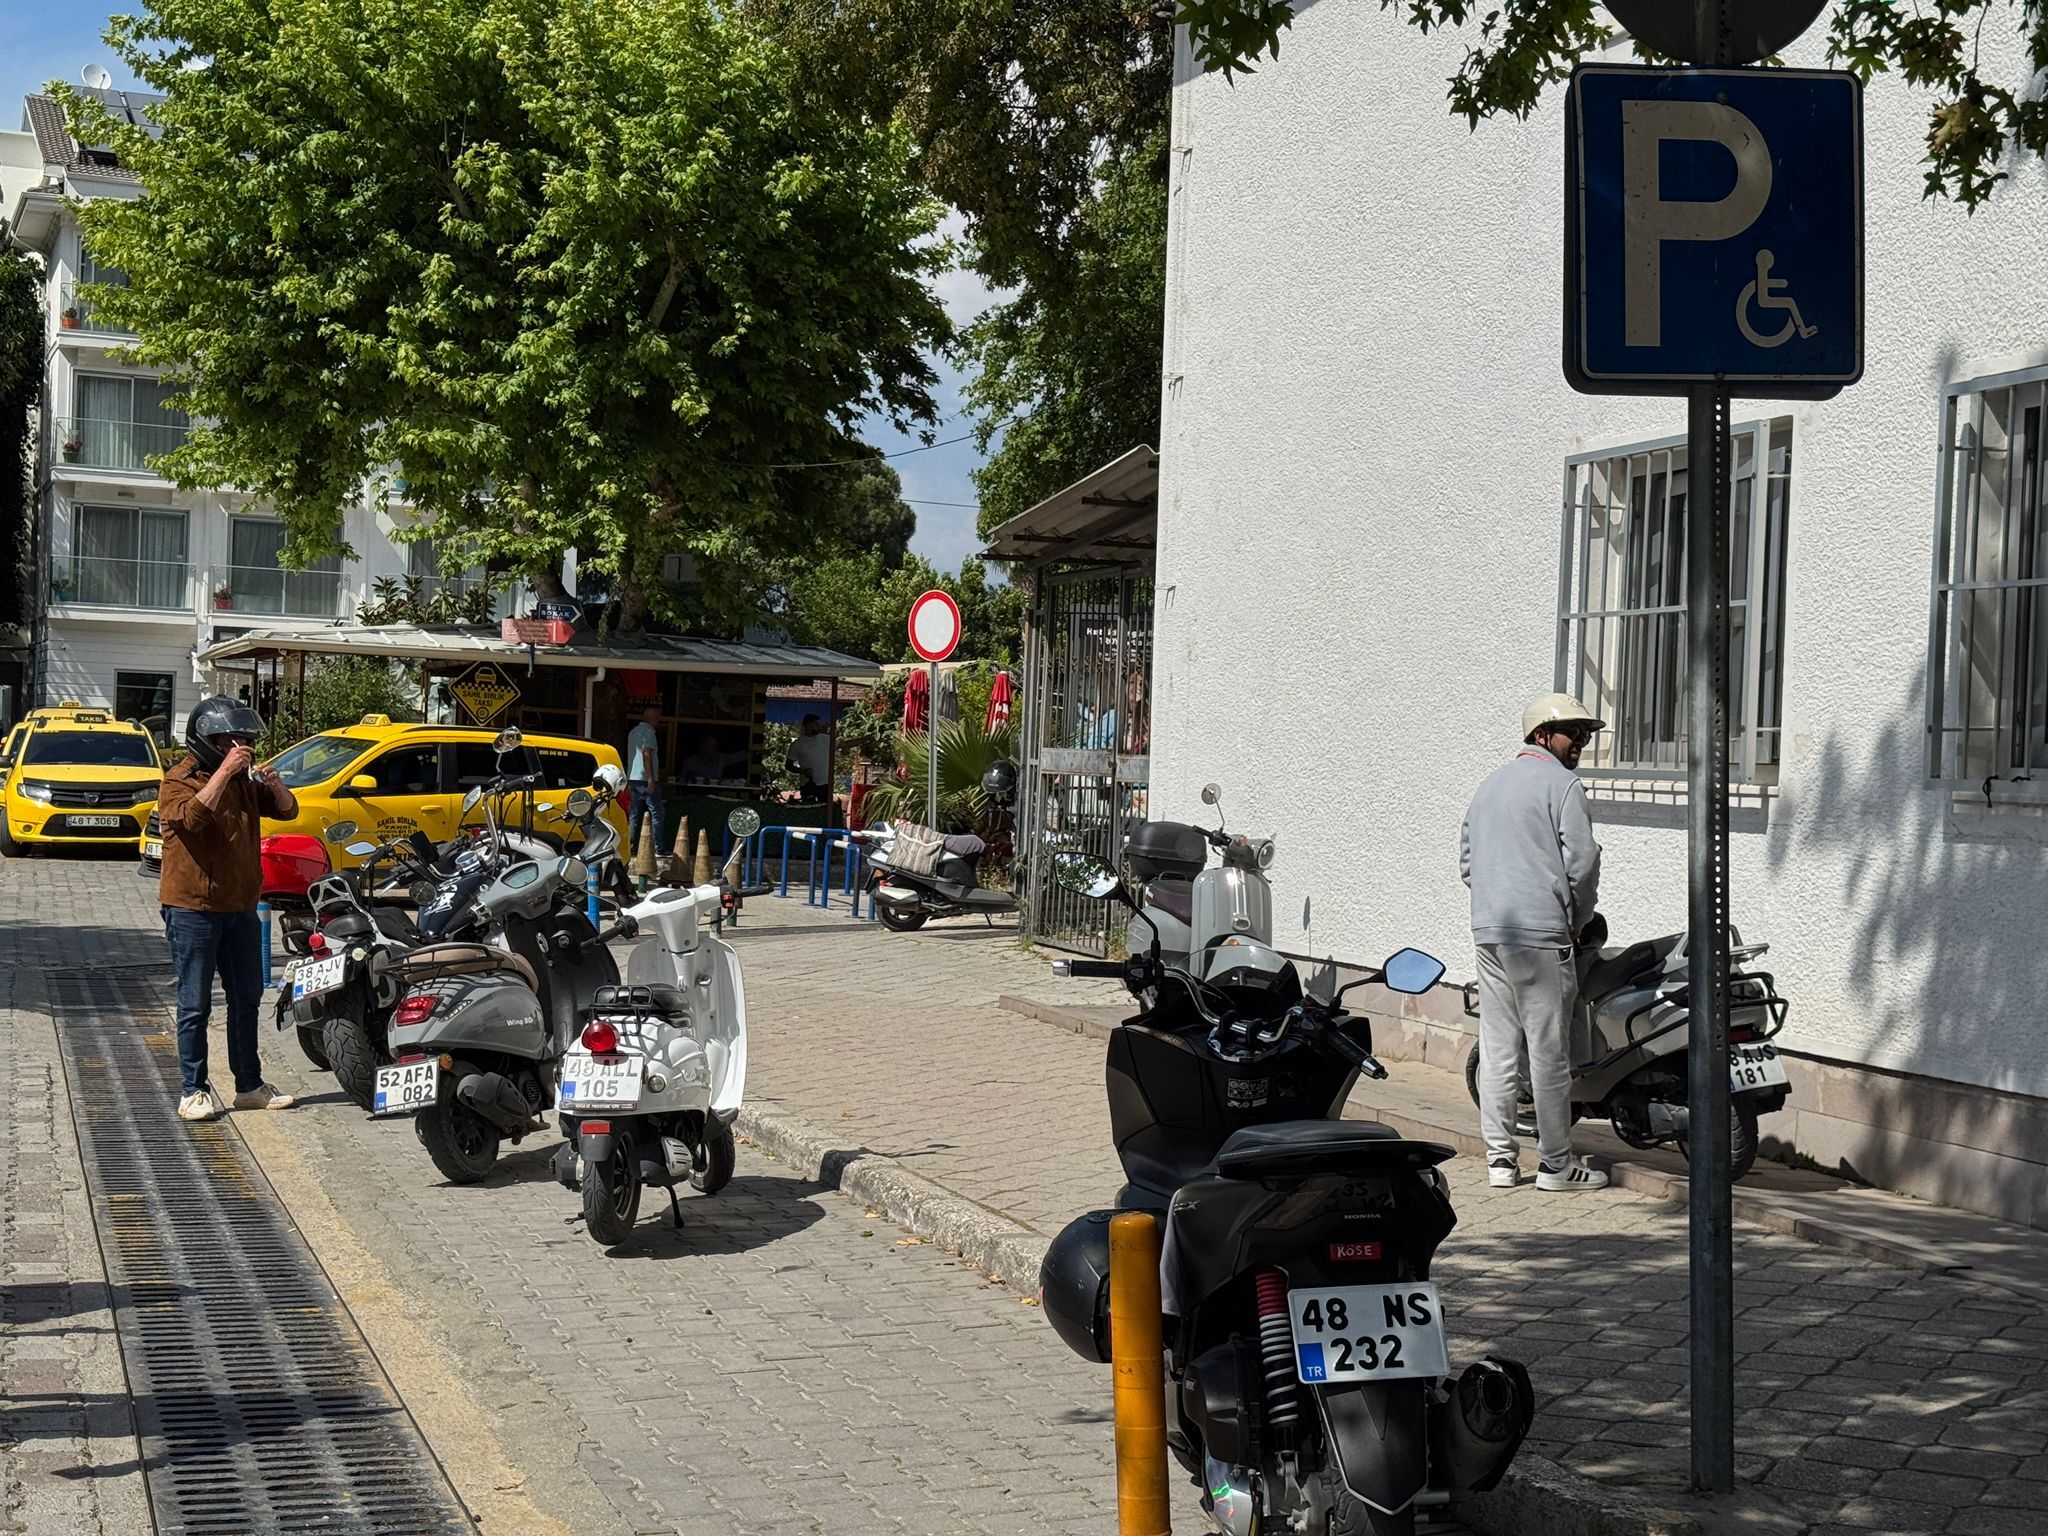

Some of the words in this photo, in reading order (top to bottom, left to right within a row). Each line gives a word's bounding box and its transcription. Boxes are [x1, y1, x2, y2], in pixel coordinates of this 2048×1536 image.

[1621, 99, 1773, 347] P
[297, 967, 313, 981] 38
[317, 957, 342, 974] AJV
[305, 975, 330, 992] 824
[1742, 1044, 1776, 1065] AJS
[380, 1071, 400, 1088] 52
[404, 1065, 434, 1085] AFA
[568, 1059, 595, 1077] 48
[599, 1058, 638, 1078] ALL
[1735, 1065, 1767, 1086] 181
[403, 1083, 433, 1103] 082
[581, 1079, 618, 1098] 105
[1301, 1296, 1349, 1333] 48
[1382, 1292, 1432, 1328] NS
[1329, 1333, 1405, 1372] 232
[1306, 1365, 1323, 1377] TR
